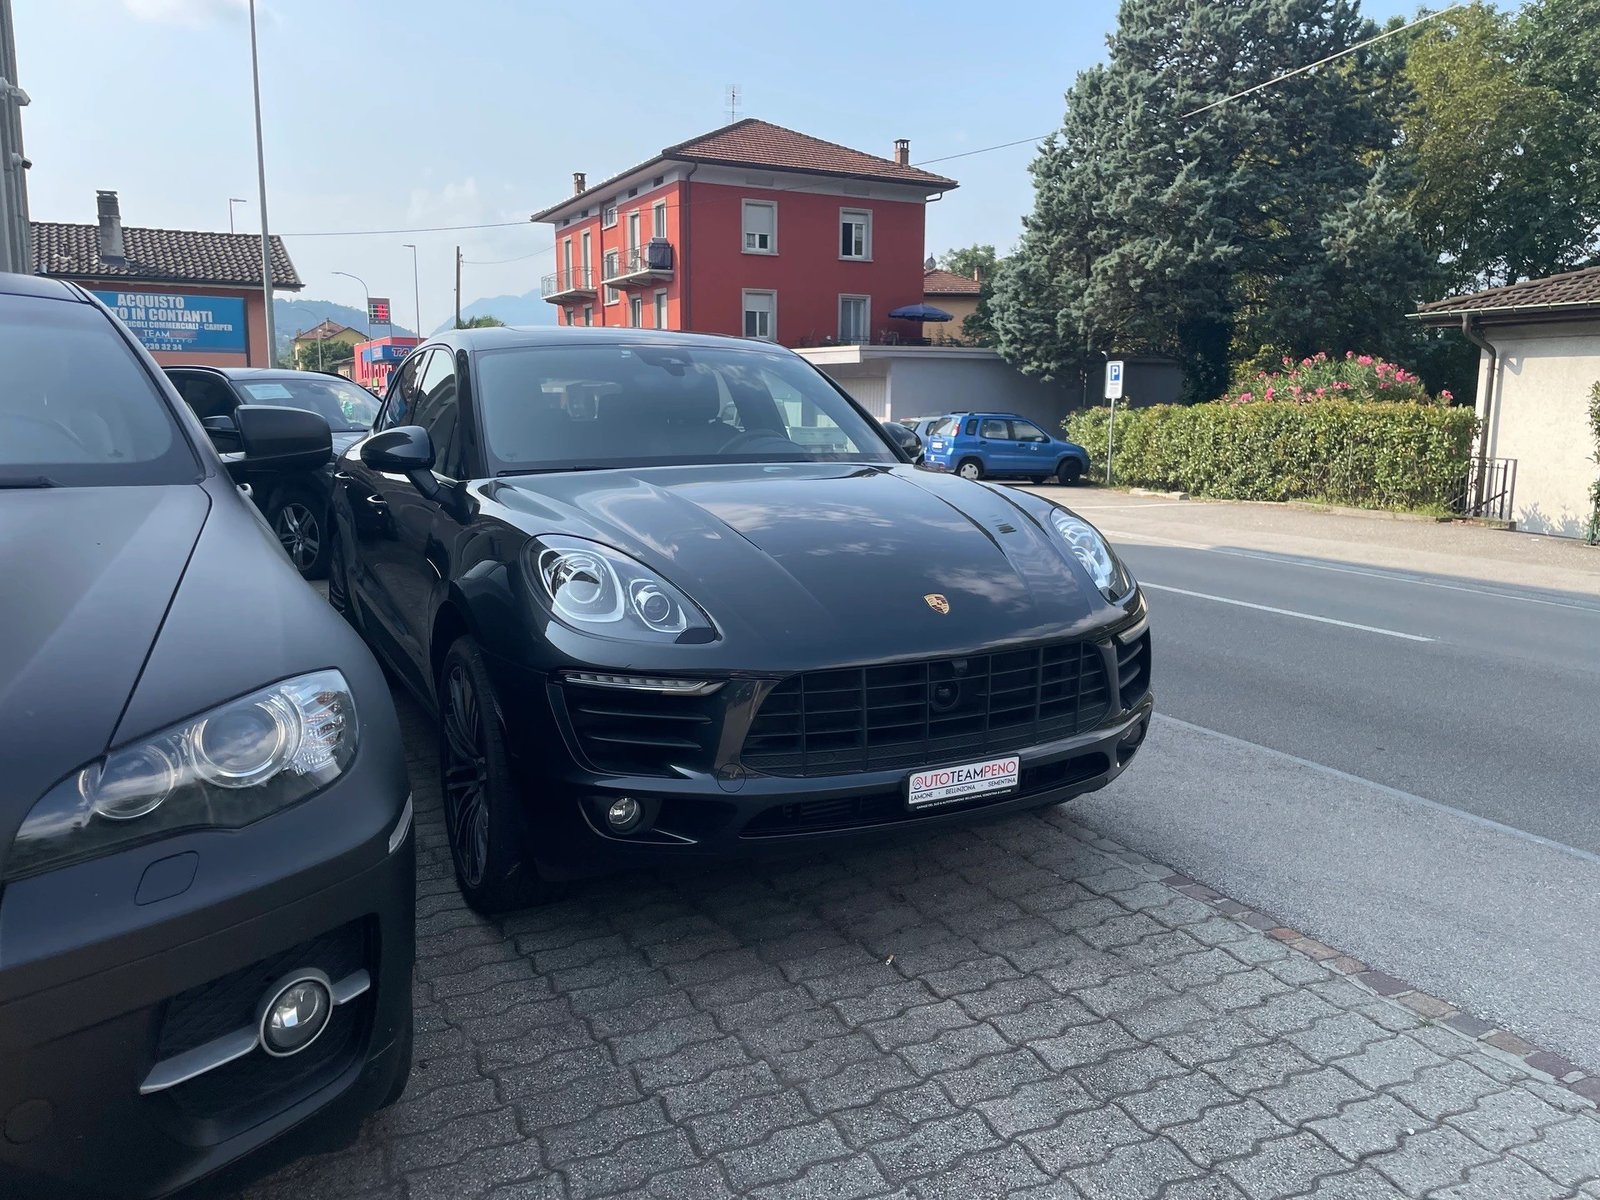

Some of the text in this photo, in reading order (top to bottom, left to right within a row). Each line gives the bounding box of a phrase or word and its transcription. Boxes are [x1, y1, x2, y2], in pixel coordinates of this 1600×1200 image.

[117, 294, 185, 308] ACQUISTO
[110, 307, 213, 323] TO IN CONTANTI
[123, 320, 148, 328] EICOLI
[149, 320, 199, 330] COMMERCIALI
[161, 343, 171, 351] 32
[391, 347, 411, 358] TA
[912, 761, 1017, 790] AUTOTEAMPENO
[910, 777, 1016, 801] LAMONE BELLINZONA SEMENTINA
